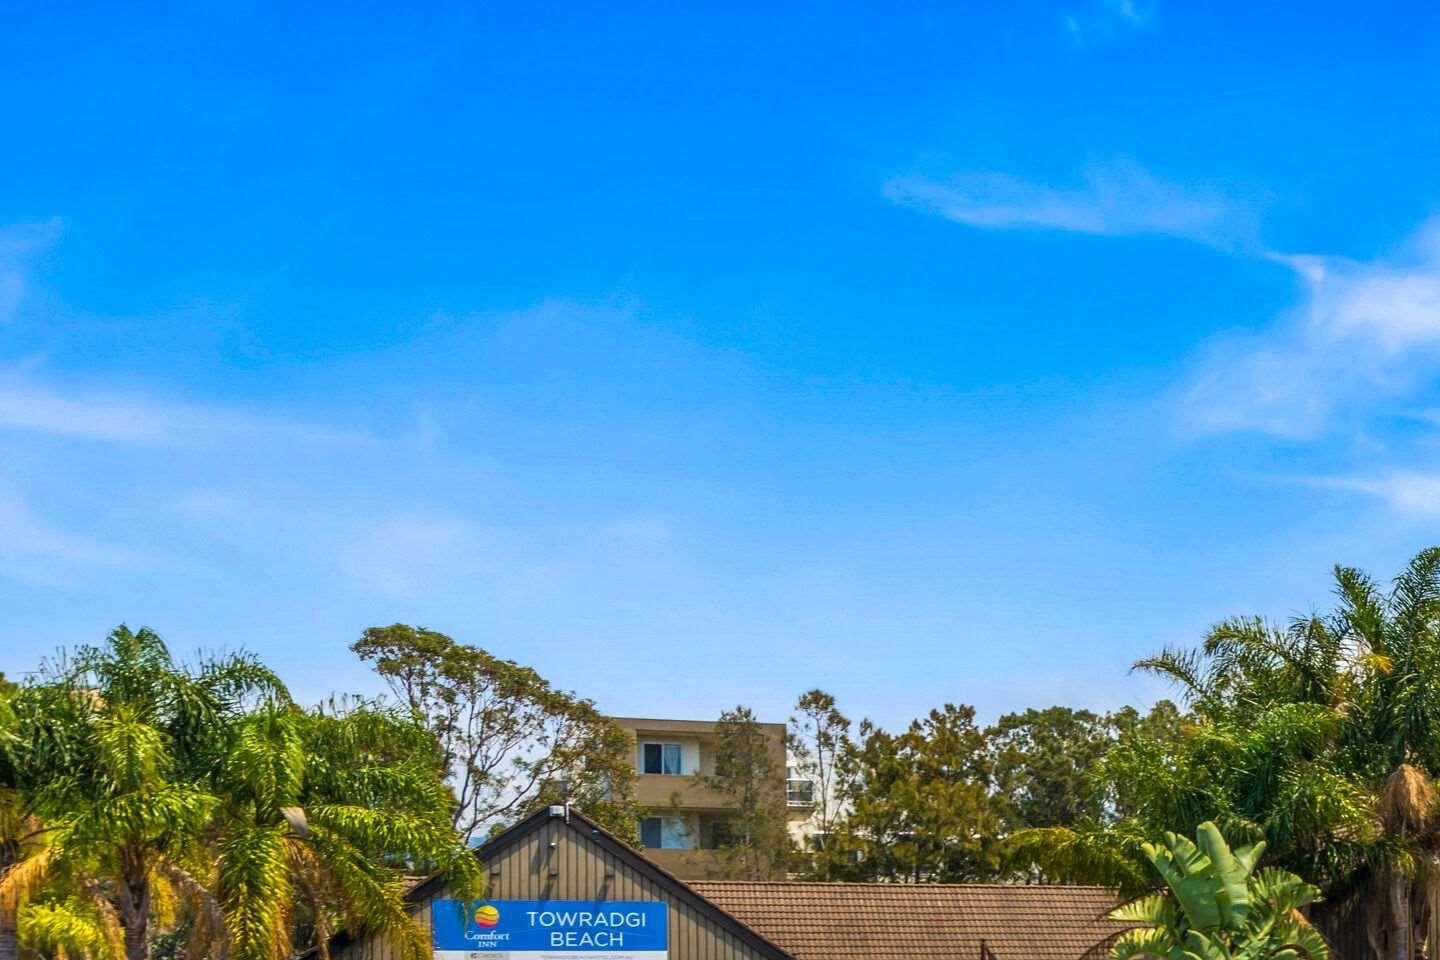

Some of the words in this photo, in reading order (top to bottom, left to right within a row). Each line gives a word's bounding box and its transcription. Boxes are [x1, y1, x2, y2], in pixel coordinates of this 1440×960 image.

[527, 911, 646, 928] TOWRADGI
[464, 930, 510, 941] Comfort
[551, 931, 624, 947] BEACH
